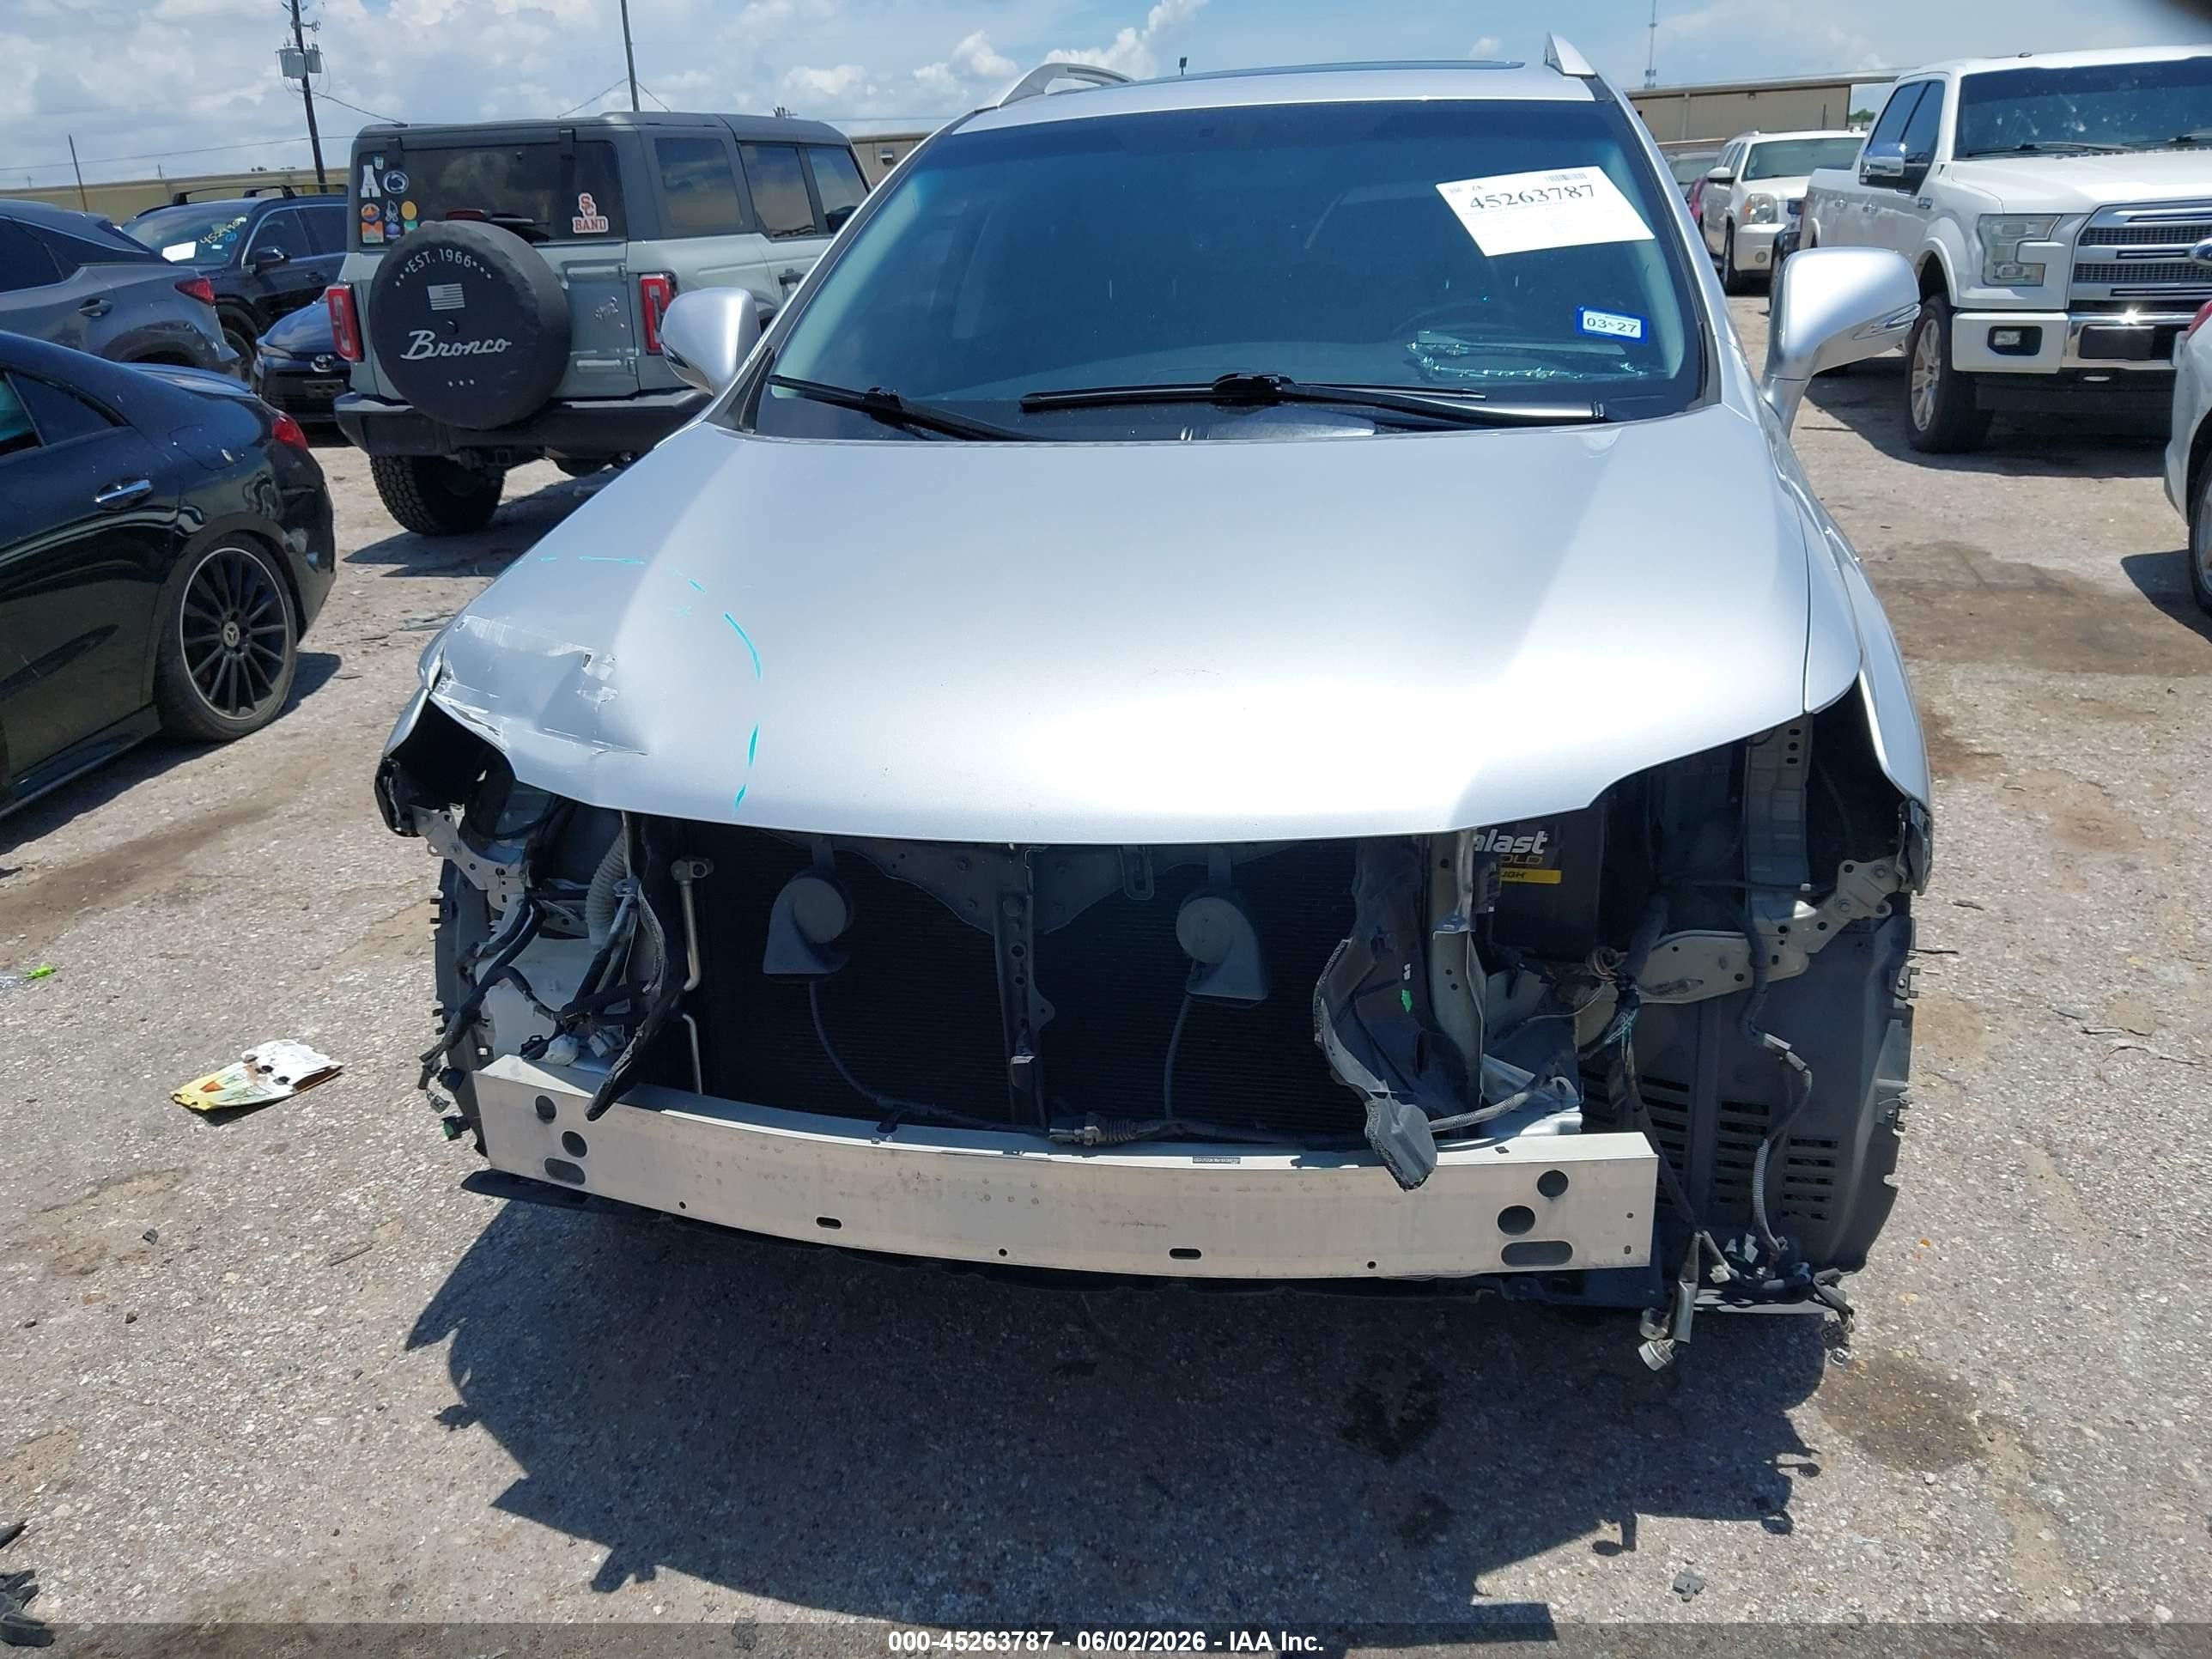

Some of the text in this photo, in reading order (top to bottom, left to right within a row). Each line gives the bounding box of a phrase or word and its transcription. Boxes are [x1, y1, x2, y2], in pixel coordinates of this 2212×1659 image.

[1469, 184, 1595, 210] 45263787
[575, 219, 605, 231] BAND
[408, 248, 472, 273] EST. 1966
[399, 330, 512, 360] Bronco
